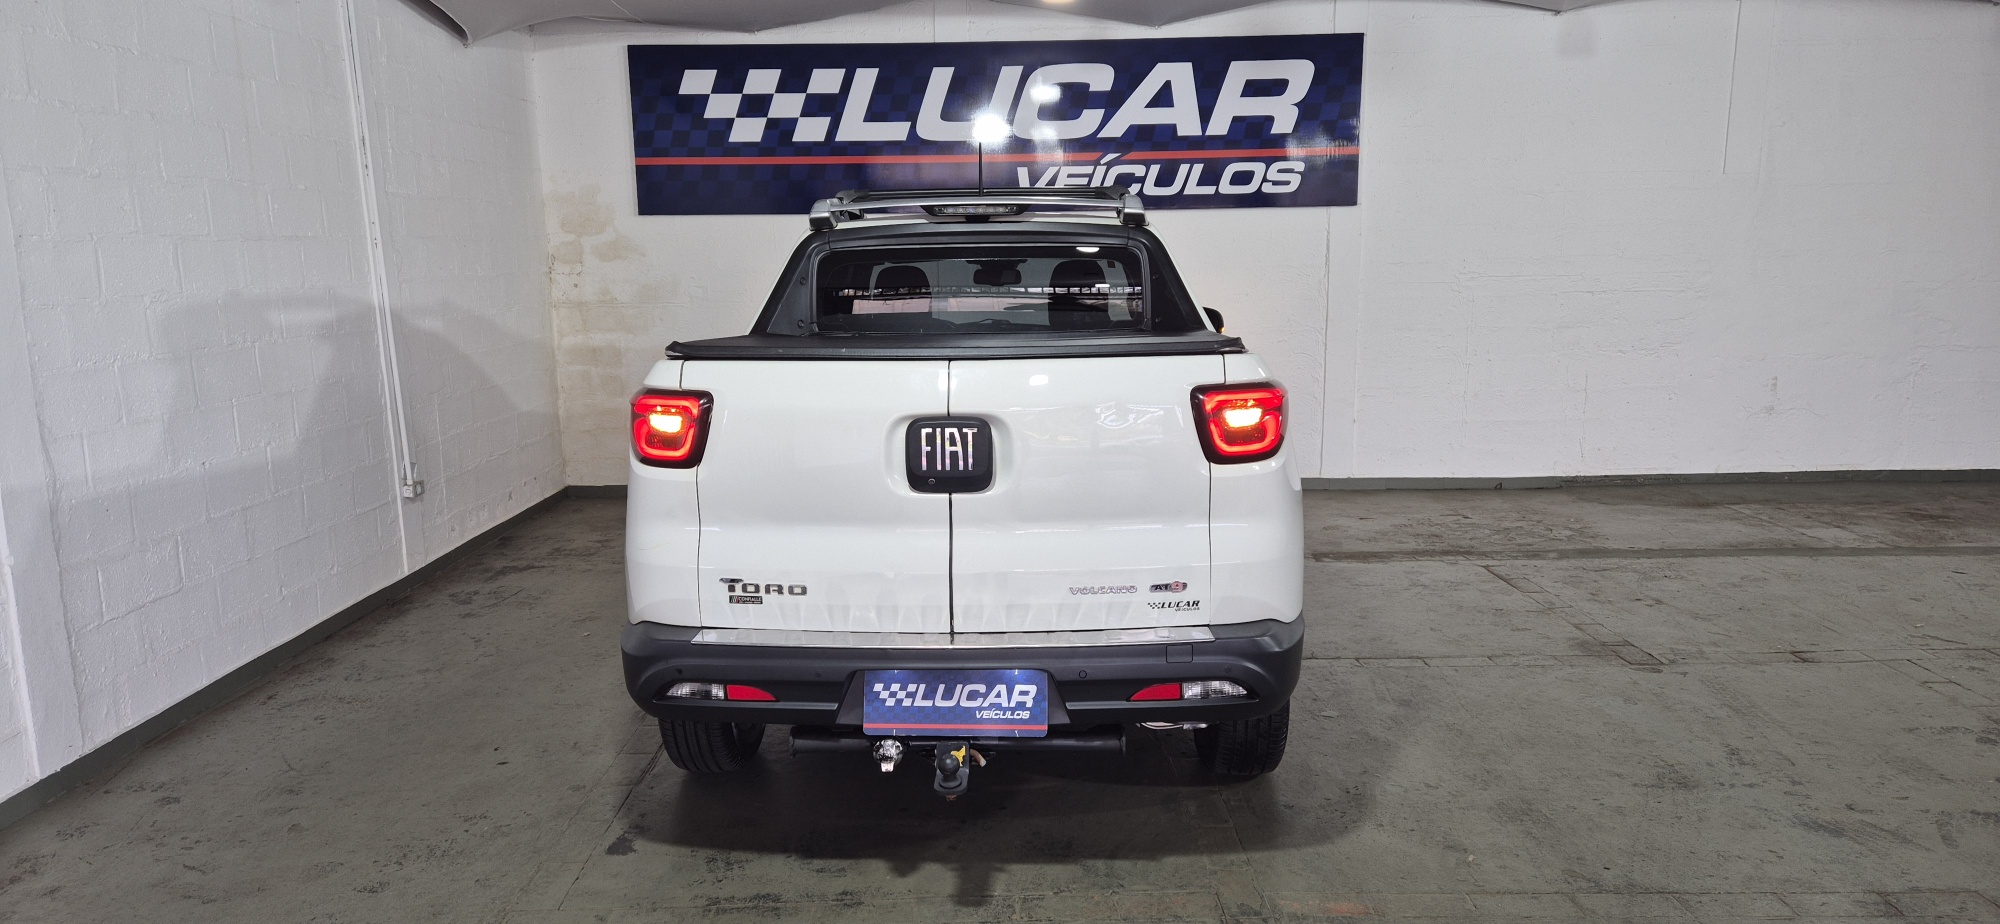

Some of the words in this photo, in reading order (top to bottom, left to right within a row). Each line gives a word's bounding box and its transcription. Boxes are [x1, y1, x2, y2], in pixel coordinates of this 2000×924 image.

[837, 59, 1315, 142] LUCAR
[1017, 153, 1305, 196] VEÍCULOS
[921, 427, 978, 470] FIAT
[719, 578, 807, 596] TORO
[1069, 585, 1138, 595] VOLCANO
[1153, 581, 1184, 593] AT9
[1161, 600, 1200, 609] LUCAR
[913, 683, 1038, 708] LUCAR
[975, 708, 1031, 719] VEÍCULOS
